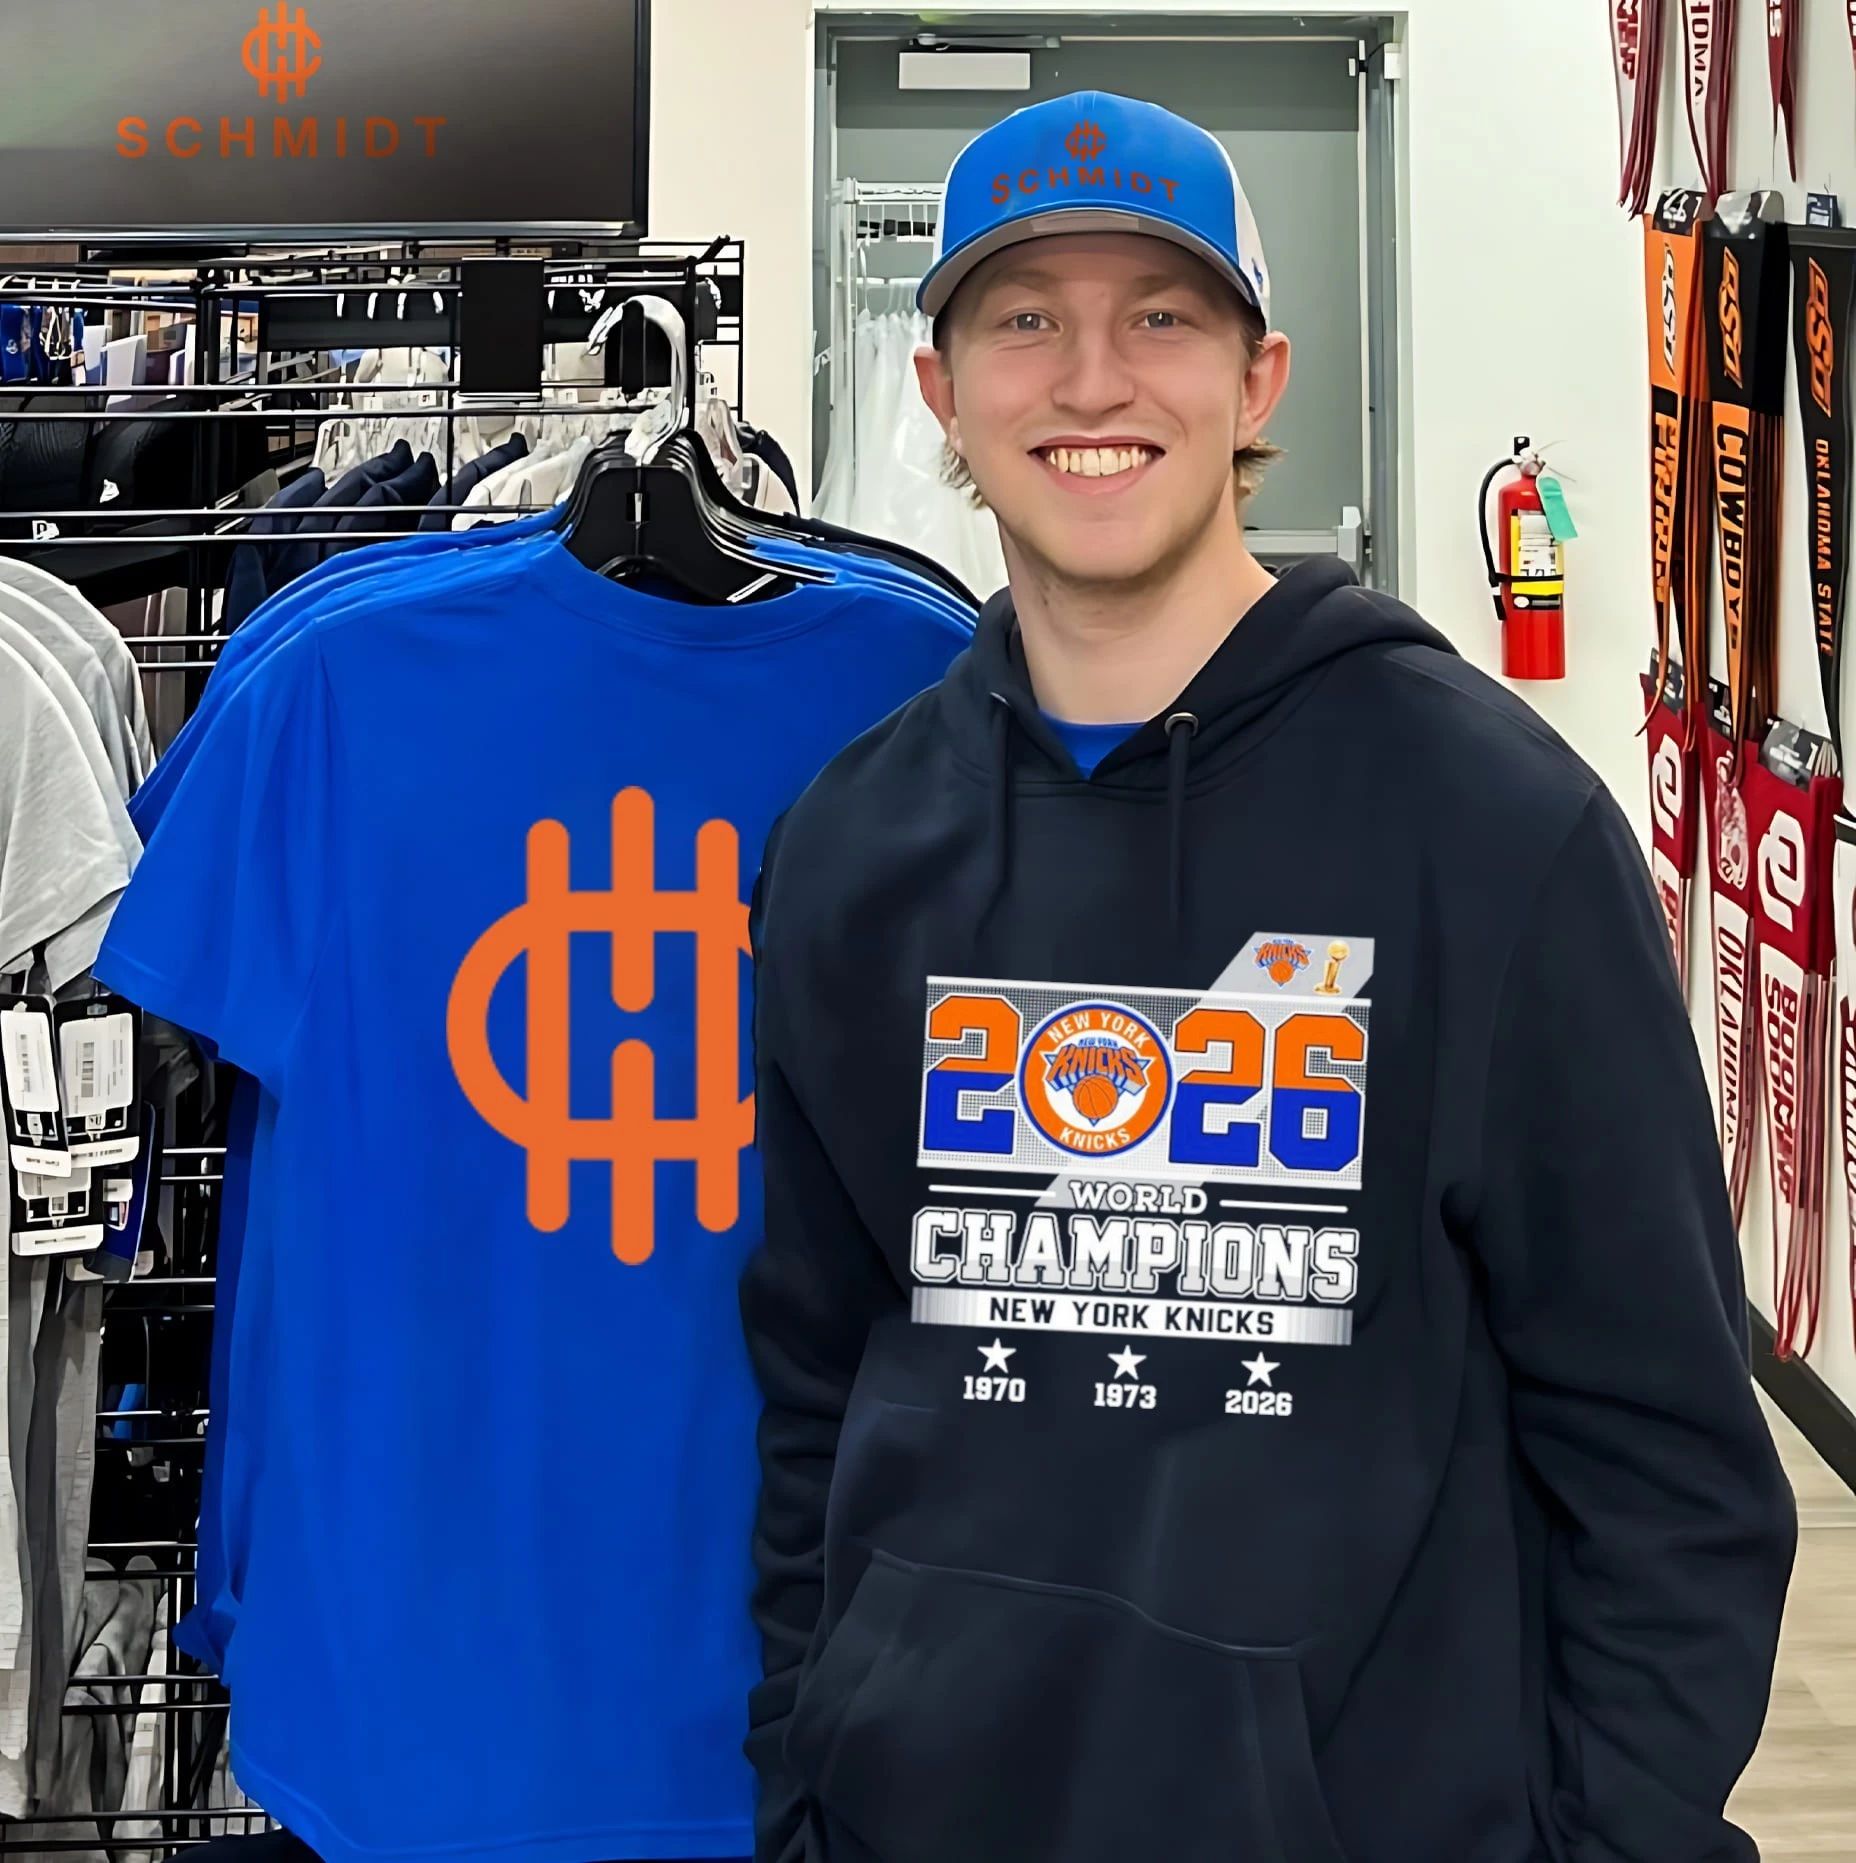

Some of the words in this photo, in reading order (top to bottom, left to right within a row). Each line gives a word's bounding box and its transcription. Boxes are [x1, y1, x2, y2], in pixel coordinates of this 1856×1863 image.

[116, 116, 448, 159] SCHMIDT
[991, 166, 1181, 205] SCHMIDT
[1815, 438, 1833, 570] OKLAHOMA
[1046, 1012, 1090, 1043] NEW
[1100, 1012, 1151, 1049] YORK
[1718, 926, 1745, 1143] OKLAHOMA
[1046, 1043, 1148, 1088] KNICKS
[1060, 1126, 1131, 1150] KNICKS
[1068, 1180, 1208, 1214] WORLD
[910, 1206, 1360, 1303] CHAMPIONS
[989, 1297, 1055, 1324] NEW
[1072, 1301, 1150, 1330] YORK
[1166, 1306, 1275, 1335] KNICKS
[963, 1375, 1026, 1402] 1970
[1094, 1382, 1157, 1410] 1973
[1225, 1389, 1293, 1416] 2026
